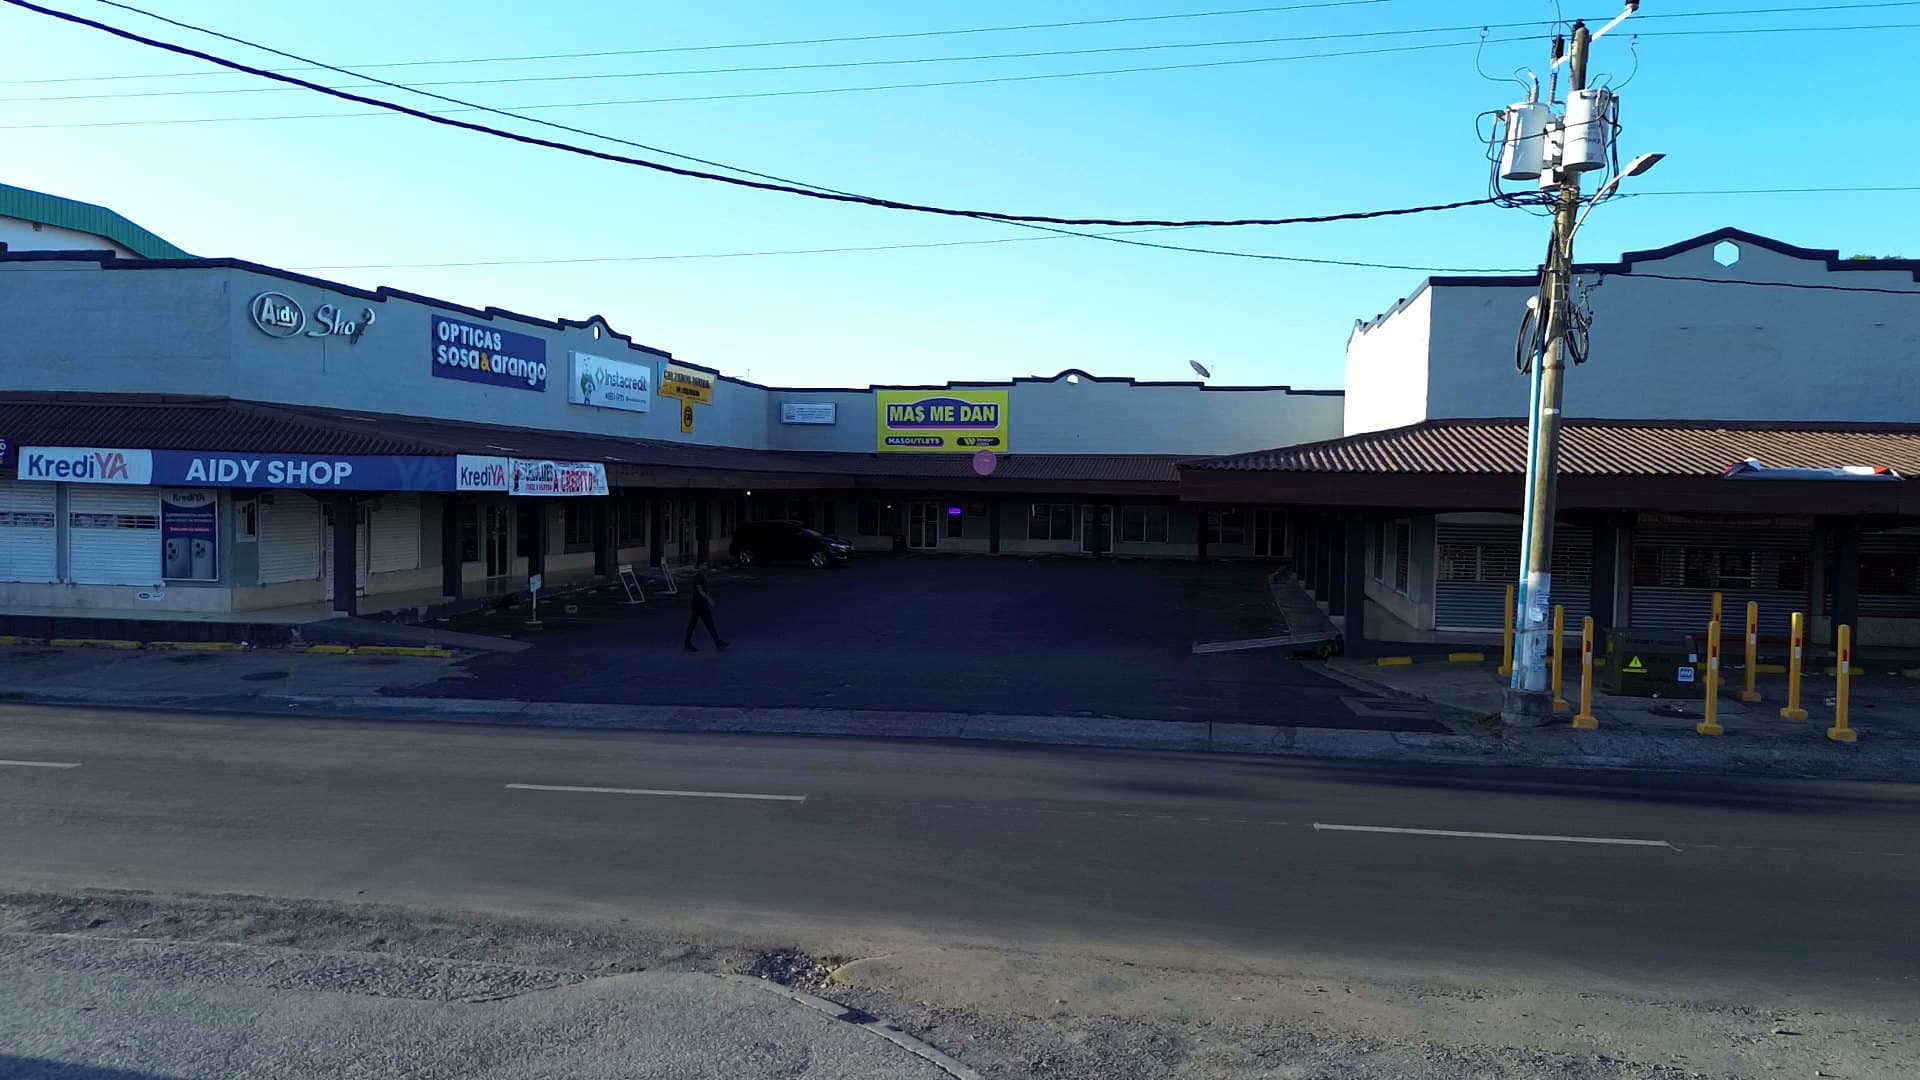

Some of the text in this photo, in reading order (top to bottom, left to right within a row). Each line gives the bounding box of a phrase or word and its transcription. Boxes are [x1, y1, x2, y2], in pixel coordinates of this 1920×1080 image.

[261, 298, 298, 327] Aidy
[438, 321, 502, 351] OPTICAS
[604, 369, 648, 393] Instacredit
[930, 406, 955, 422] ME
[960, 406, 995, 422] DAN
[28, 452, 129, 480] KrediYA
[185, 458, 353, 485] AIDY SHOP
[460, 463, 506, 487] KrediYA
